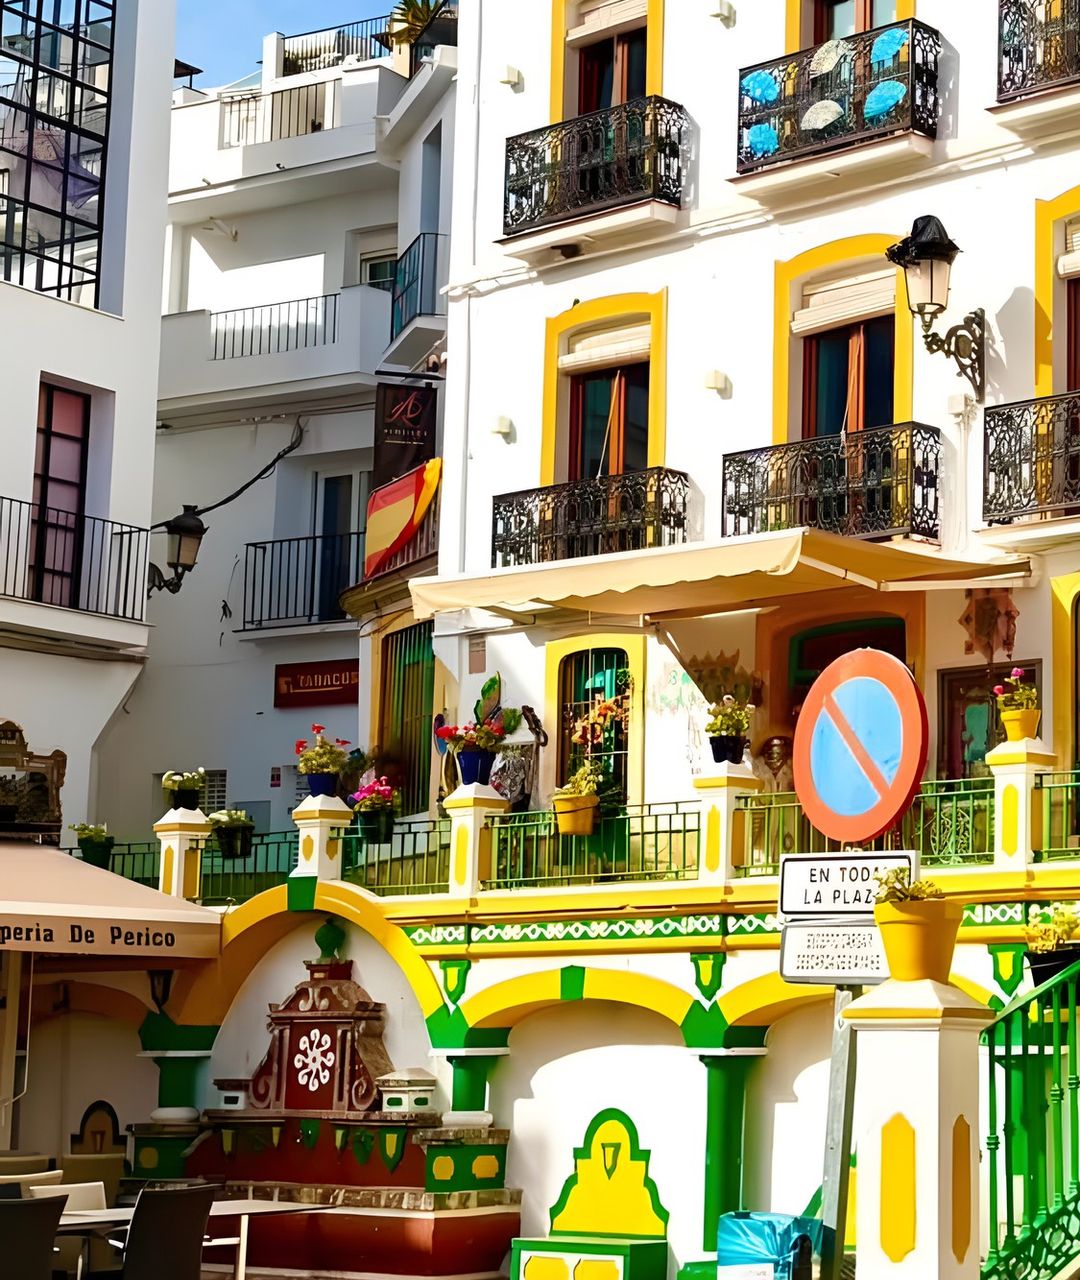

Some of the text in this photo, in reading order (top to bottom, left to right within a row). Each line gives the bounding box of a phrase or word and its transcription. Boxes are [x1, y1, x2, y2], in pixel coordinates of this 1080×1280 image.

[809, 866, 879, 882] EN TOD
[804, 888, 874, 904] LA PLAZ
[69, 924, 95, 944] De
[110, 926, 175, 947] Perico
